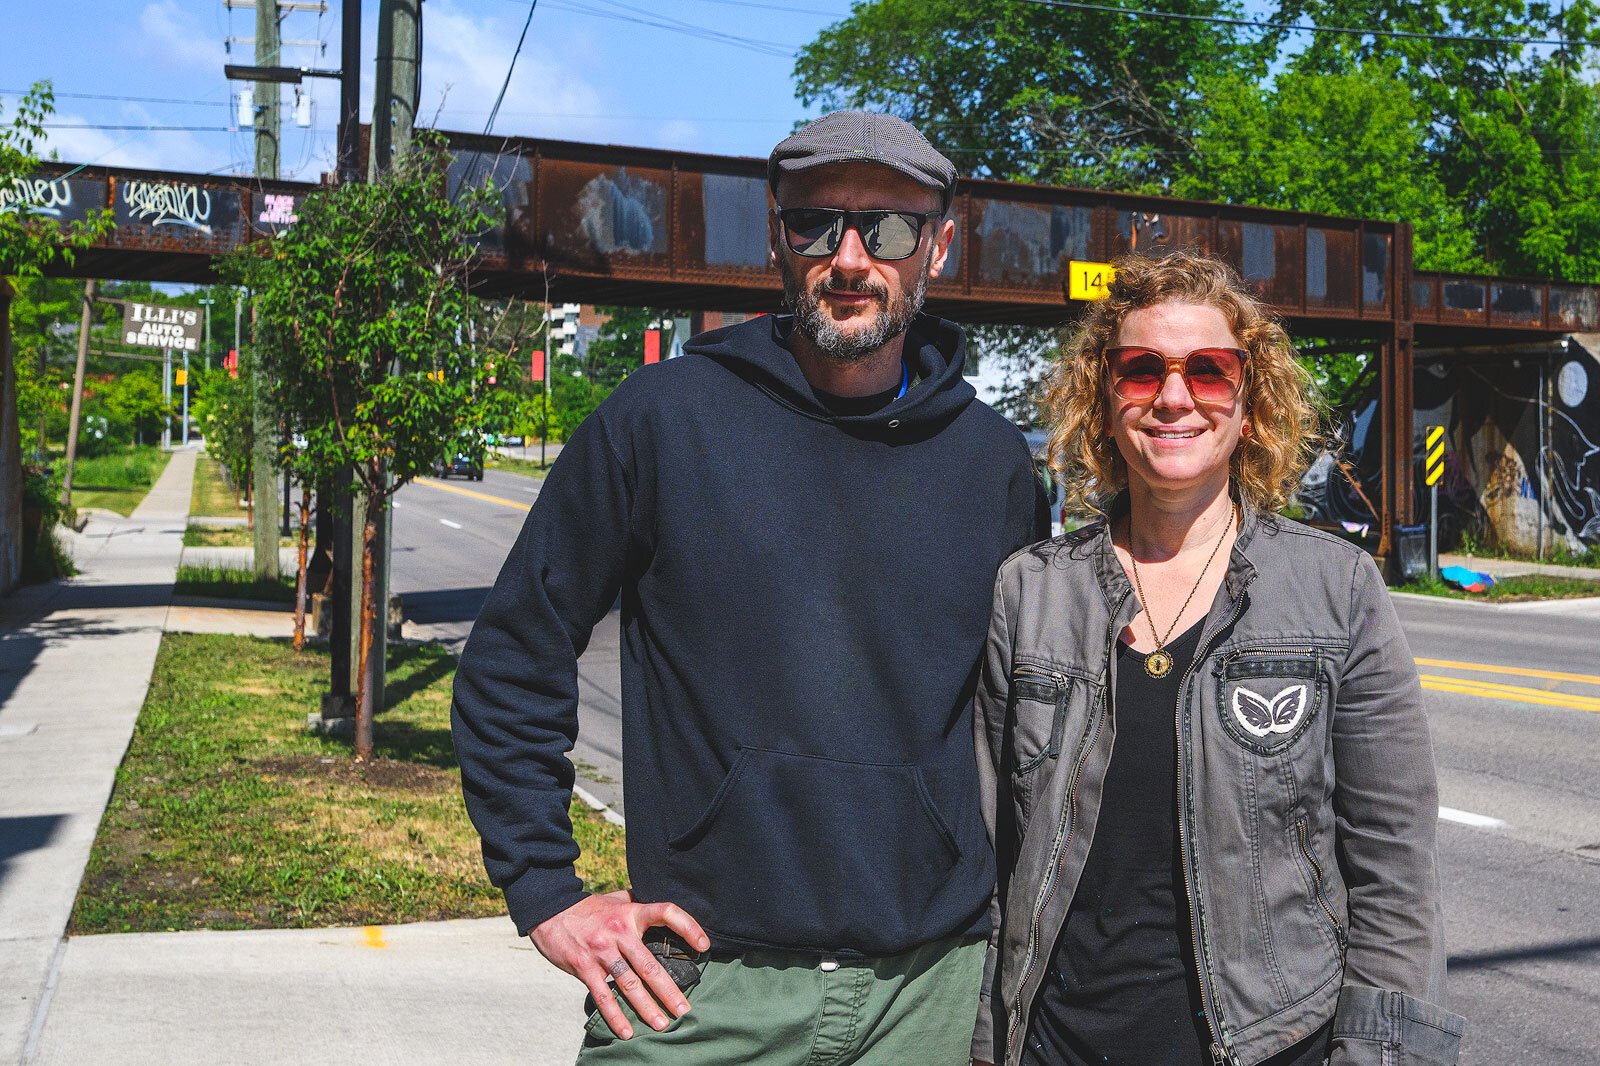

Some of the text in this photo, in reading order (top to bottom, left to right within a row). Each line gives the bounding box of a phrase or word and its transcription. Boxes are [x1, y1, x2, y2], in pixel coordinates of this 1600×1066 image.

[1084, 271, 1107, 291] 14
[131, 303, 197, 326] ILLI'S
[141, 322, 184, 338] AUTO
[126, 331, 196, 350] SERVICE
